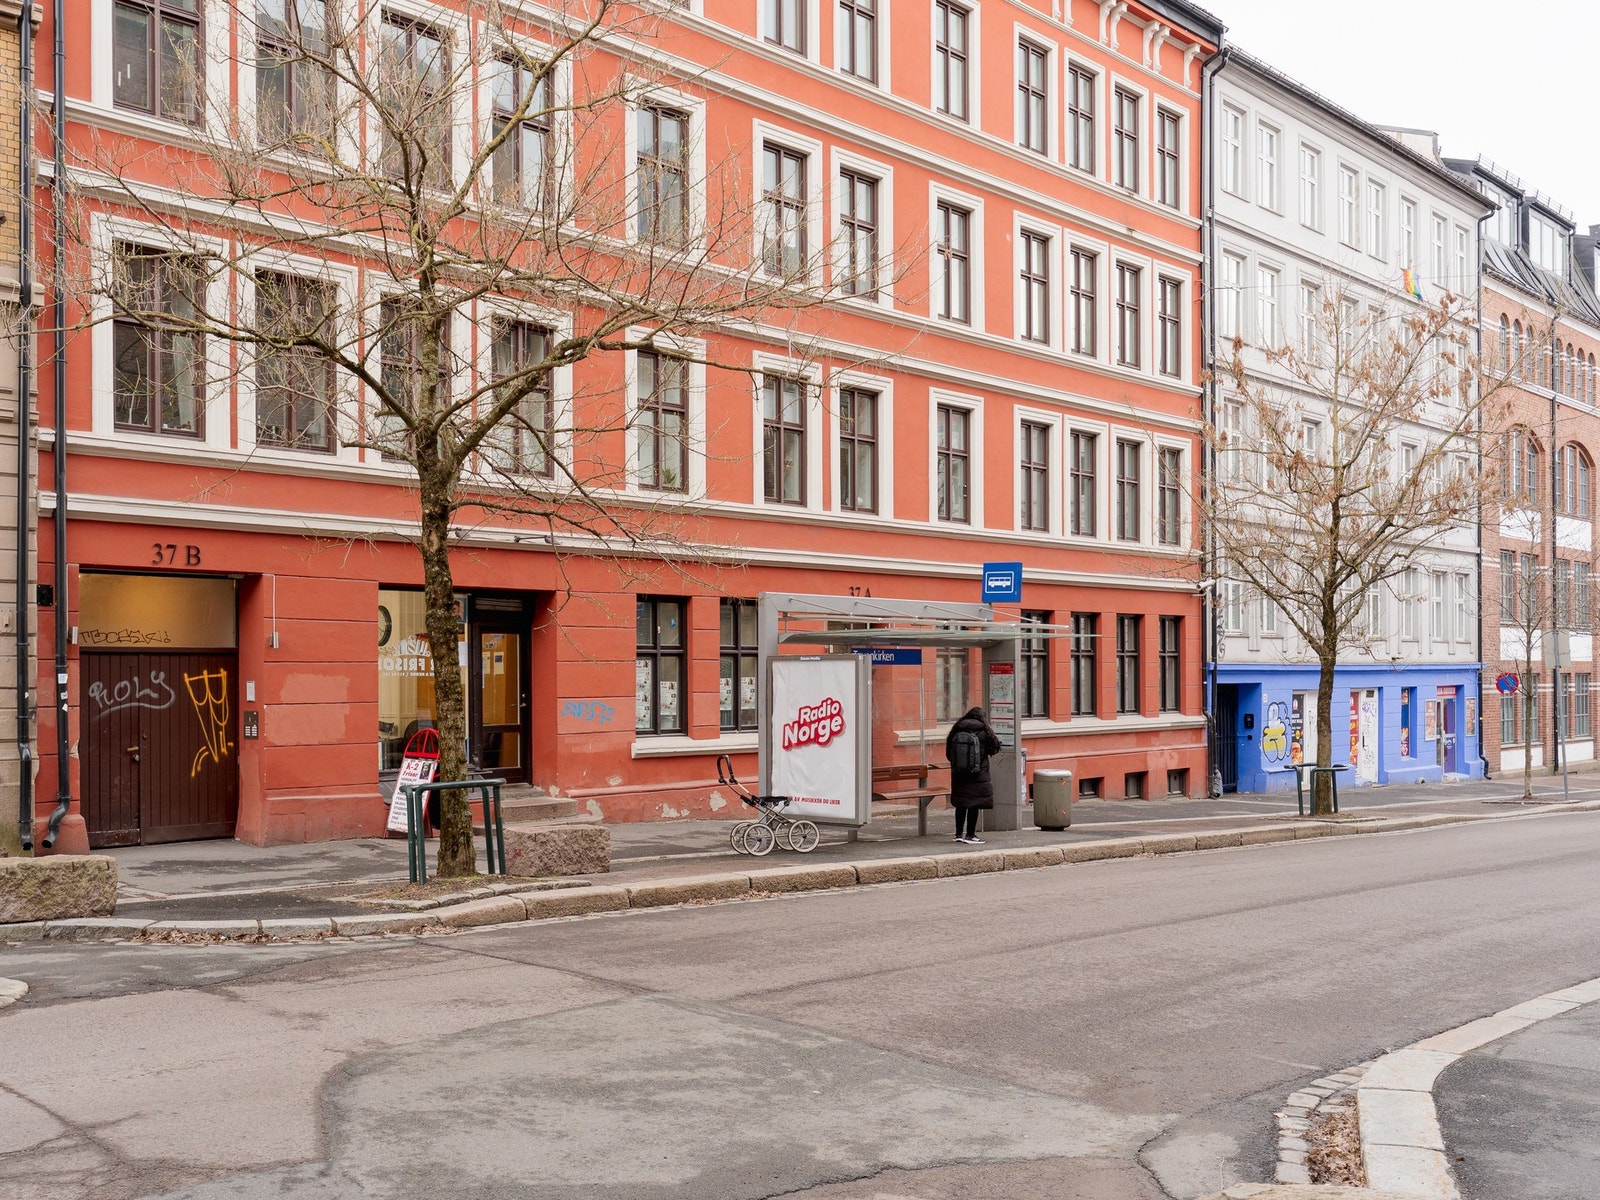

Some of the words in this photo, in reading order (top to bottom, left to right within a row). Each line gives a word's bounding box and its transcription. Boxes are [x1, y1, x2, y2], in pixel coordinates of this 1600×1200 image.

[152, 543, 177, 565] 37
[186, 545, 201, 566] B
[849, 586, 861, 597] 37
[865, 587, 872, 598] A
[800, 699, 840, 724] Radio
[783, 715, 843, 747] Norge
